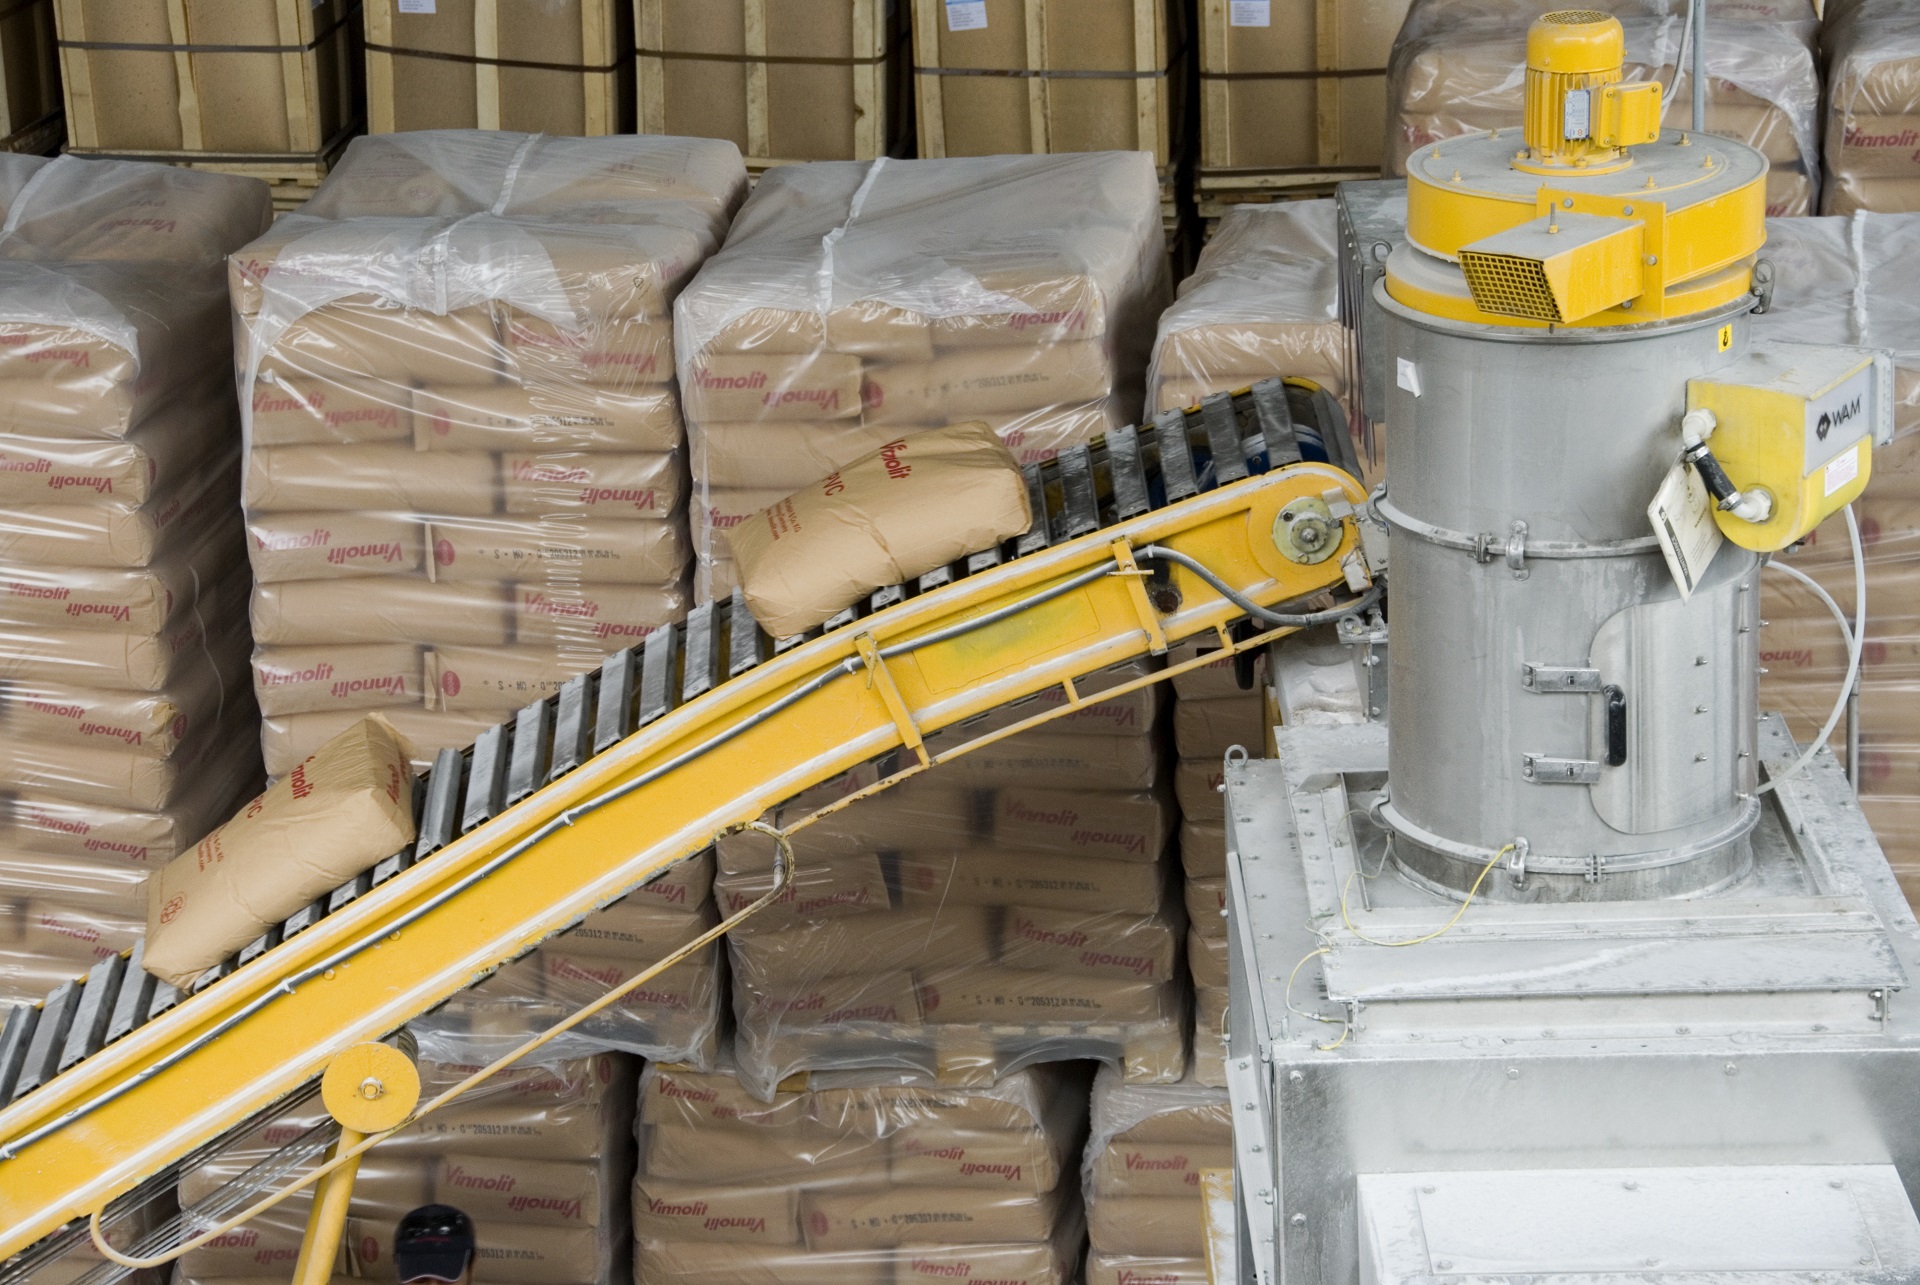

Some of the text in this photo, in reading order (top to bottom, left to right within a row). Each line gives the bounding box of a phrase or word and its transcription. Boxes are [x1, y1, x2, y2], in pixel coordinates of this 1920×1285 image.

[1843, 127, 1919, 147] Vinnolit
[693, 368, 768, 389] Vinnolit
[1832, 396, 1861, 427] WAM
[48, 476, 113, 494] Vinnolit
[579, 488, 655, 510] Vinnolit
[327, 542, 403, 564] Vinnolit
[9, 582, 70, 600] Vinnolit
[65, 602, 130, 621] Vinnolit
[259, 663, 334, 686] Vinnolit
[331, 675, 405, 698] Vinnolit
[24, 693, 86, 719] Vinnolit
[79, 722, 142, 746] Vinnolit
[83, 838, 147, 861] Vinnolit
[1071, 830, 1146, 854] Vinnolit
[1014, 916, 1088, 947] Vinnolit
[1080, 951, 1154, 978] Vinnolit
[658, 1078, 719, 1101] Vinnolit
[960, 1162, 1021, 1181] Vinnolit
[1125, 1152, 1188, 1171] Vinnolit
[446, 1165, 516, 1192] Vinnolit
[508, 1196, 582, 1219] Vinnolit
[649, 1199, 708, 1217] Vinnolit
[704, 1217, 766, 1233] Vinnolit
[911, 1258, 971, 1277] Vinnolit
